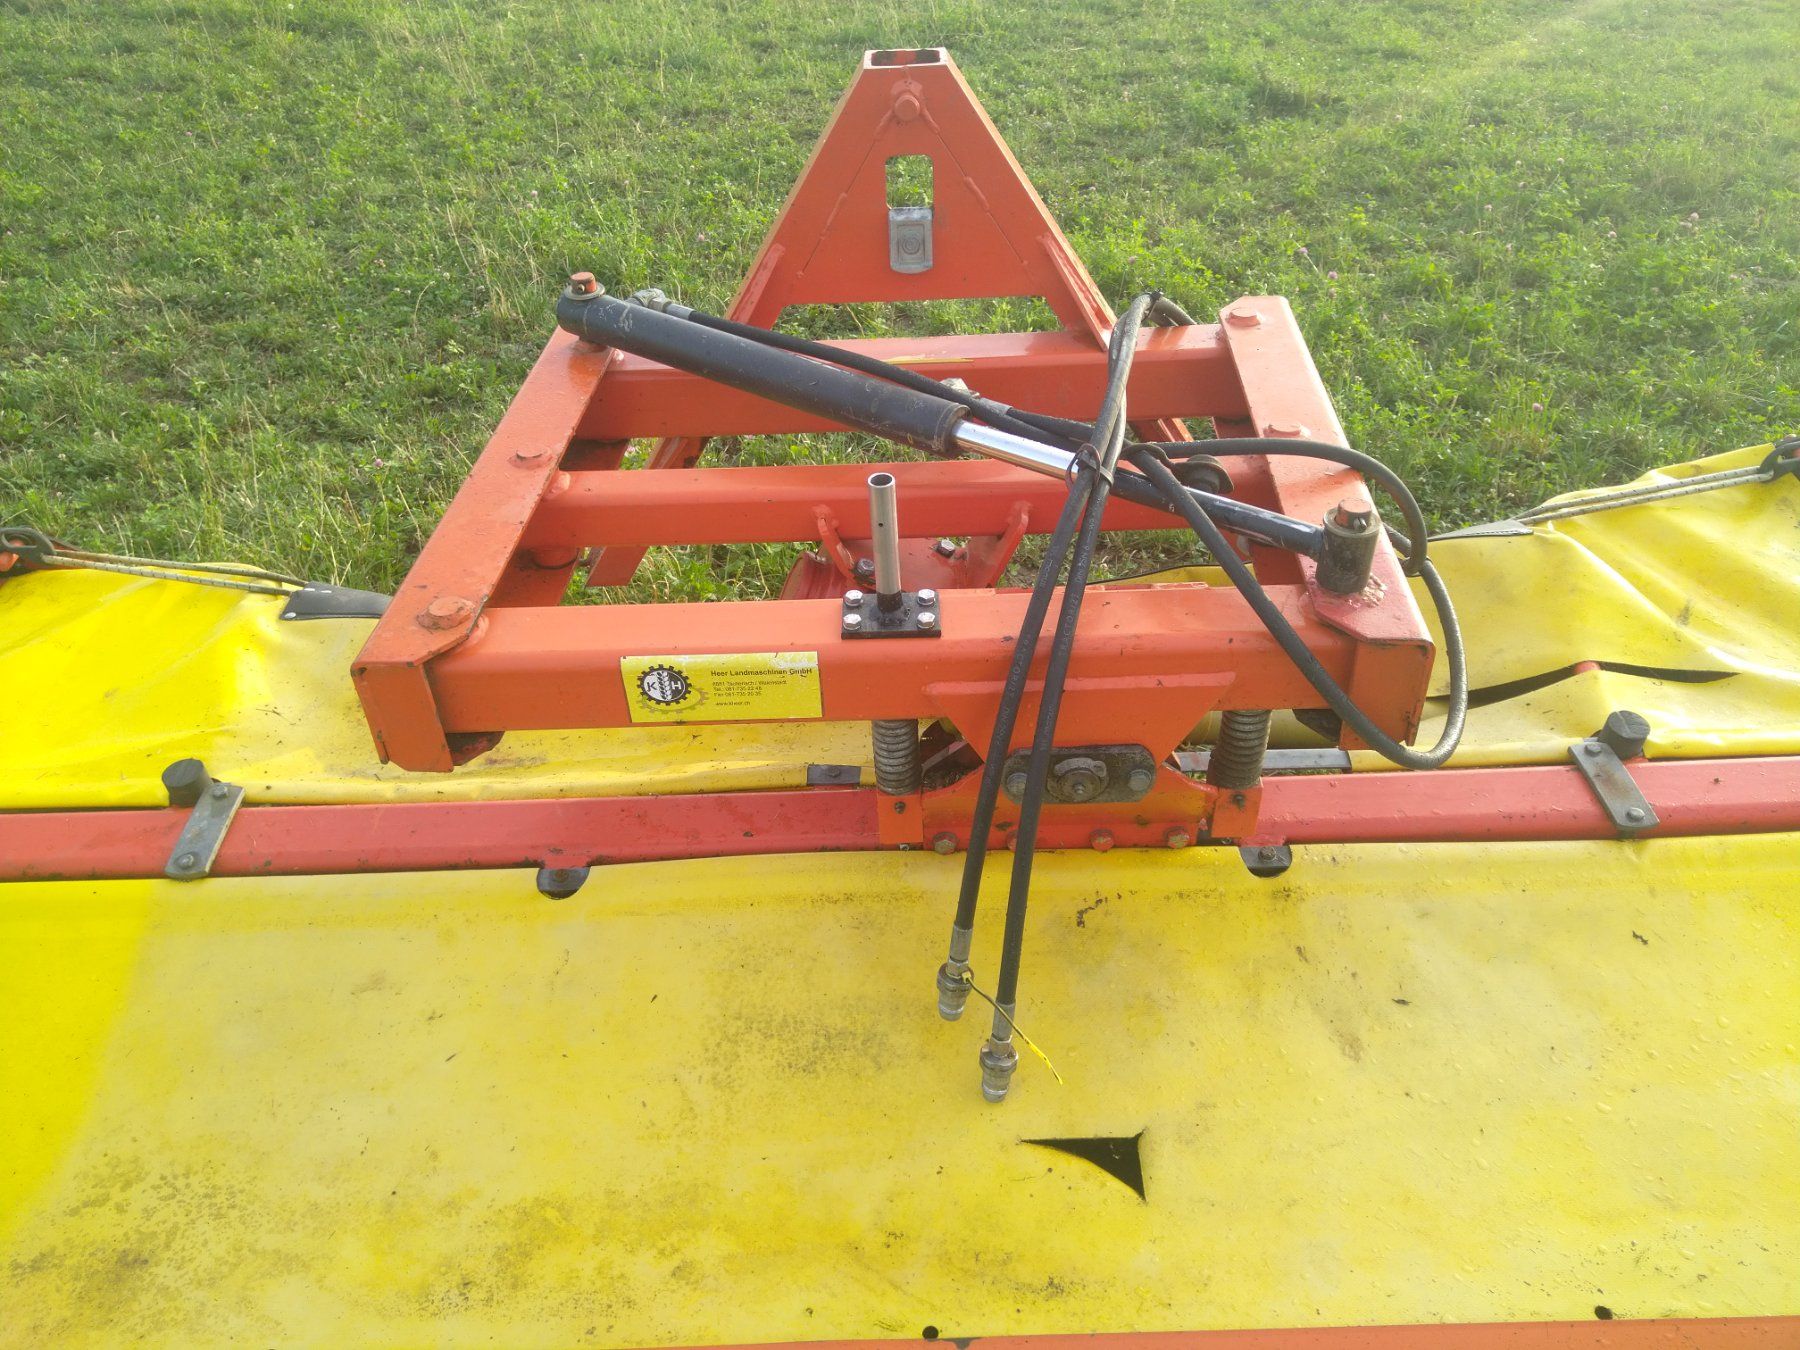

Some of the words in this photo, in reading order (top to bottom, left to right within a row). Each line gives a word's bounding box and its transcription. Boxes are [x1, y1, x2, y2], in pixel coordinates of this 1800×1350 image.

[711, 669, 728, 677] Heer
[729, 668, 788, 676] Landmaschinen
[789, 667, 813, 675] GmbH
